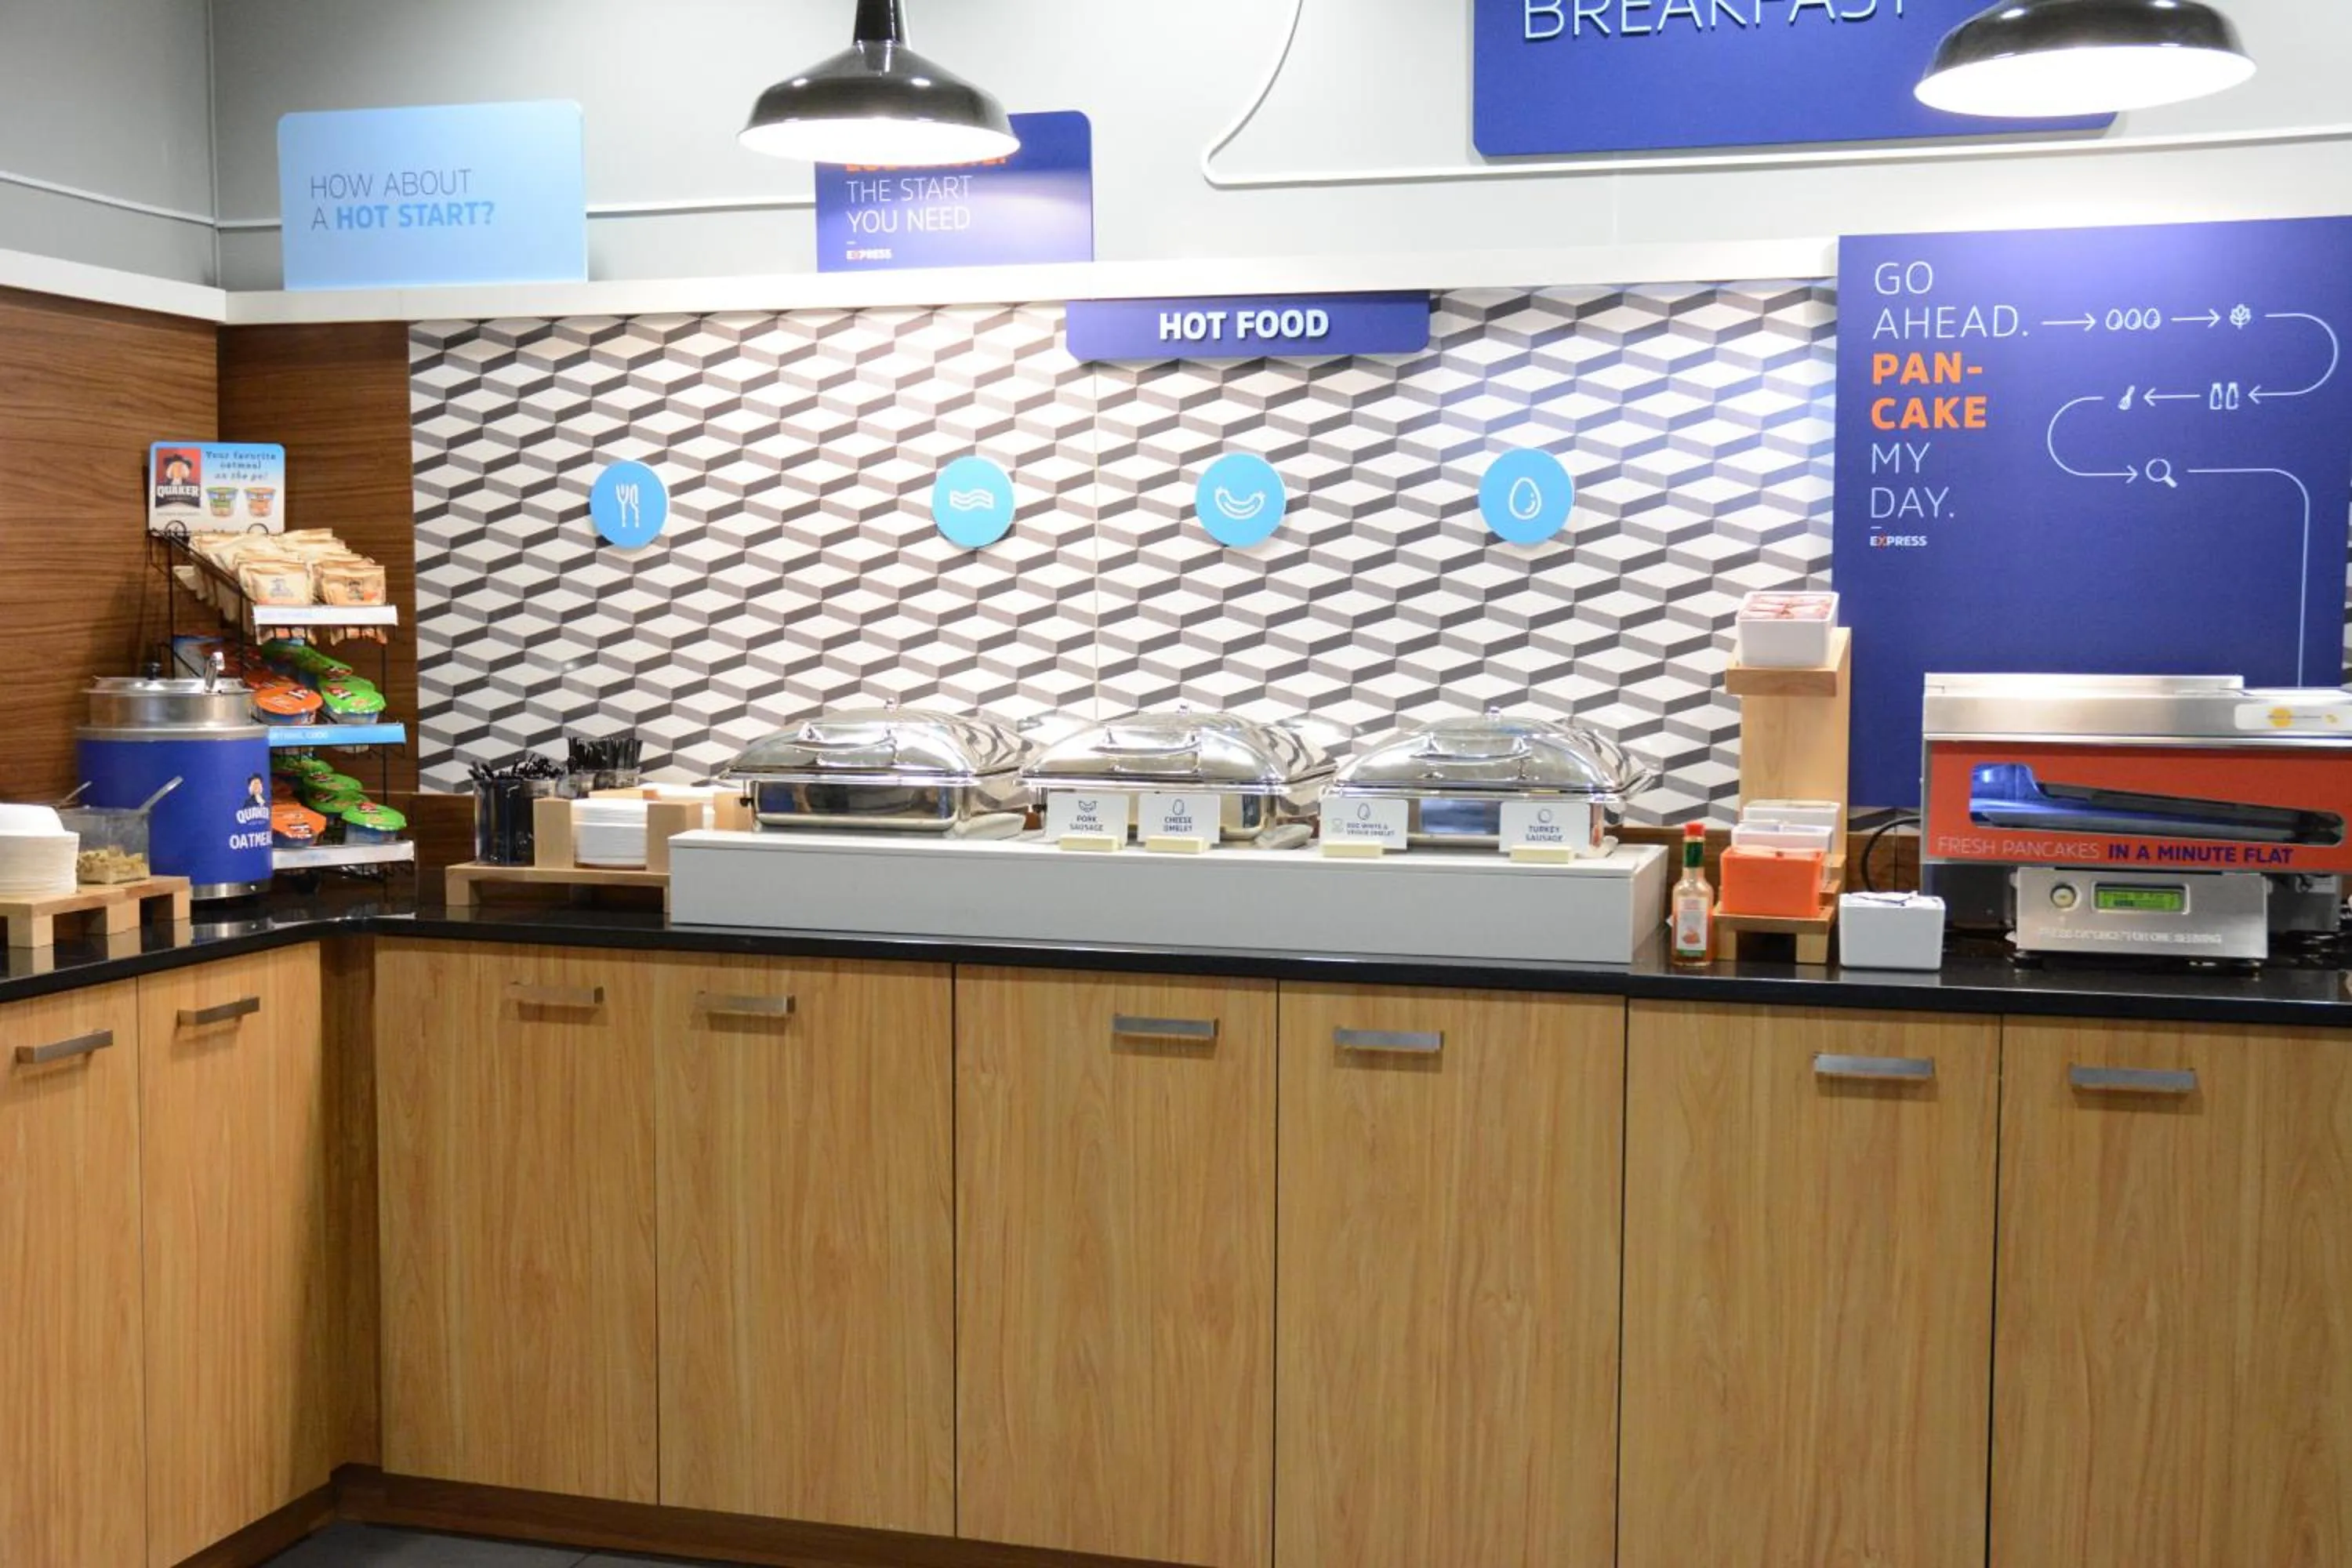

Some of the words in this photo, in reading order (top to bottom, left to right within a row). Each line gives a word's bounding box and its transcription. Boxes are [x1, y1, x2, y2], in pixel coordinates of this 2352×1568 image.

[1525, 0, 1904, 39] BREAK
[310, 173, 373, 199] HOW
[383, 169, 472, 197] ABOUT
[847, 179, 891, 203] THE
[900, 175, 974, 202] START
[311, 206, 329, 231] A
[336, 205, 389, 230] HOT
[398, 200, 495, 227] START?
[846, 209, 898, 234] YOU
[907, 205, 971, 232] NEED
[846, 249, 892, 260] EXPRESS
[1874, 260, 1933, 296] GO
[1159, 311, 1229, 340] HOT
[1236, 309, 1330, 339] FOOD
[1872, 303, 2030, 340] AHEAD.
[1871, 350, 1984, 386] PAN-
[1870, 395, 1988, 430] CAKE
[1871, 441, 1931, 475] MY
[157, 485, 199, 499] QUAKER
[1870, 485, 1955, 519] DAY.
[1869, 535, 1928, 547] EXPRESS
[1076, 815, 1098, 823] PORK
[1529, 825, 1560, 833] TURKEY
[1526, 833, 1563, 842] SAUSAGE
[1937, 836, 1995, 855] FRESH
[2002, 840, 2100, 859] PANCAKES
[2107, 844, 2129, 860] IN
[2135, 846, 2151, 861] A
[2157, 845, 2238, 862] MINUTE
[2243, 848, 2294, 864] FLAT
